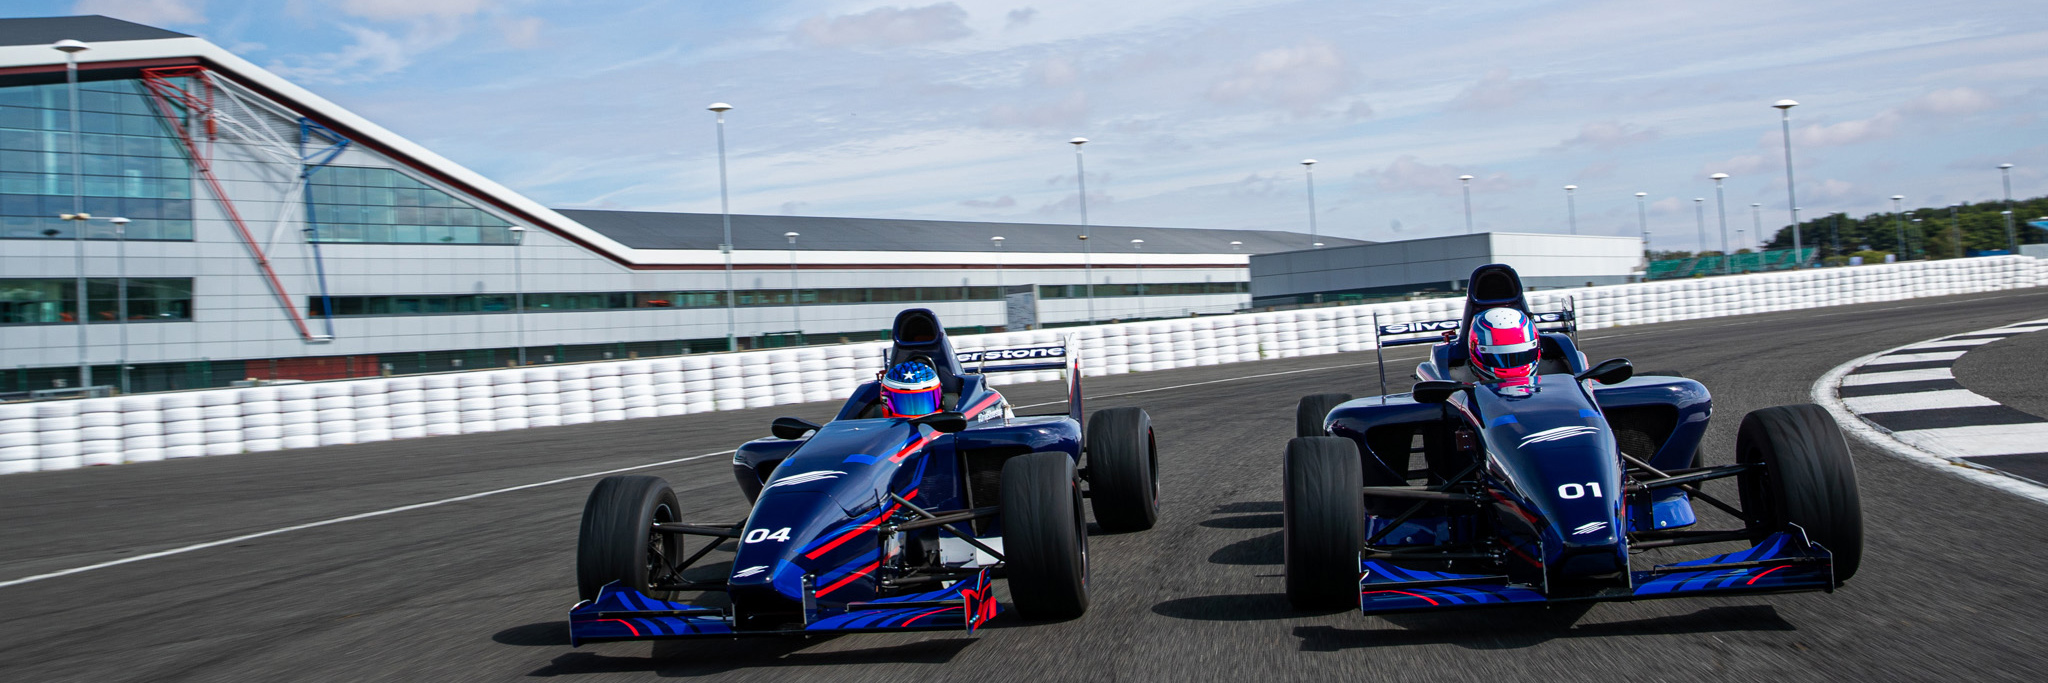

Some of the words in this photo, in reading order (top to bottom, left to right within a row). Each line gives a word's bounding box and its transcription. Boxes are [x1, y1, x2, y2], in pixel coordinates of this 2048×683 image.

[957, 347, 1065, 362] erstone
[1558, 482, 1603, 499] 01
[745, 527, 792, 544] 04
